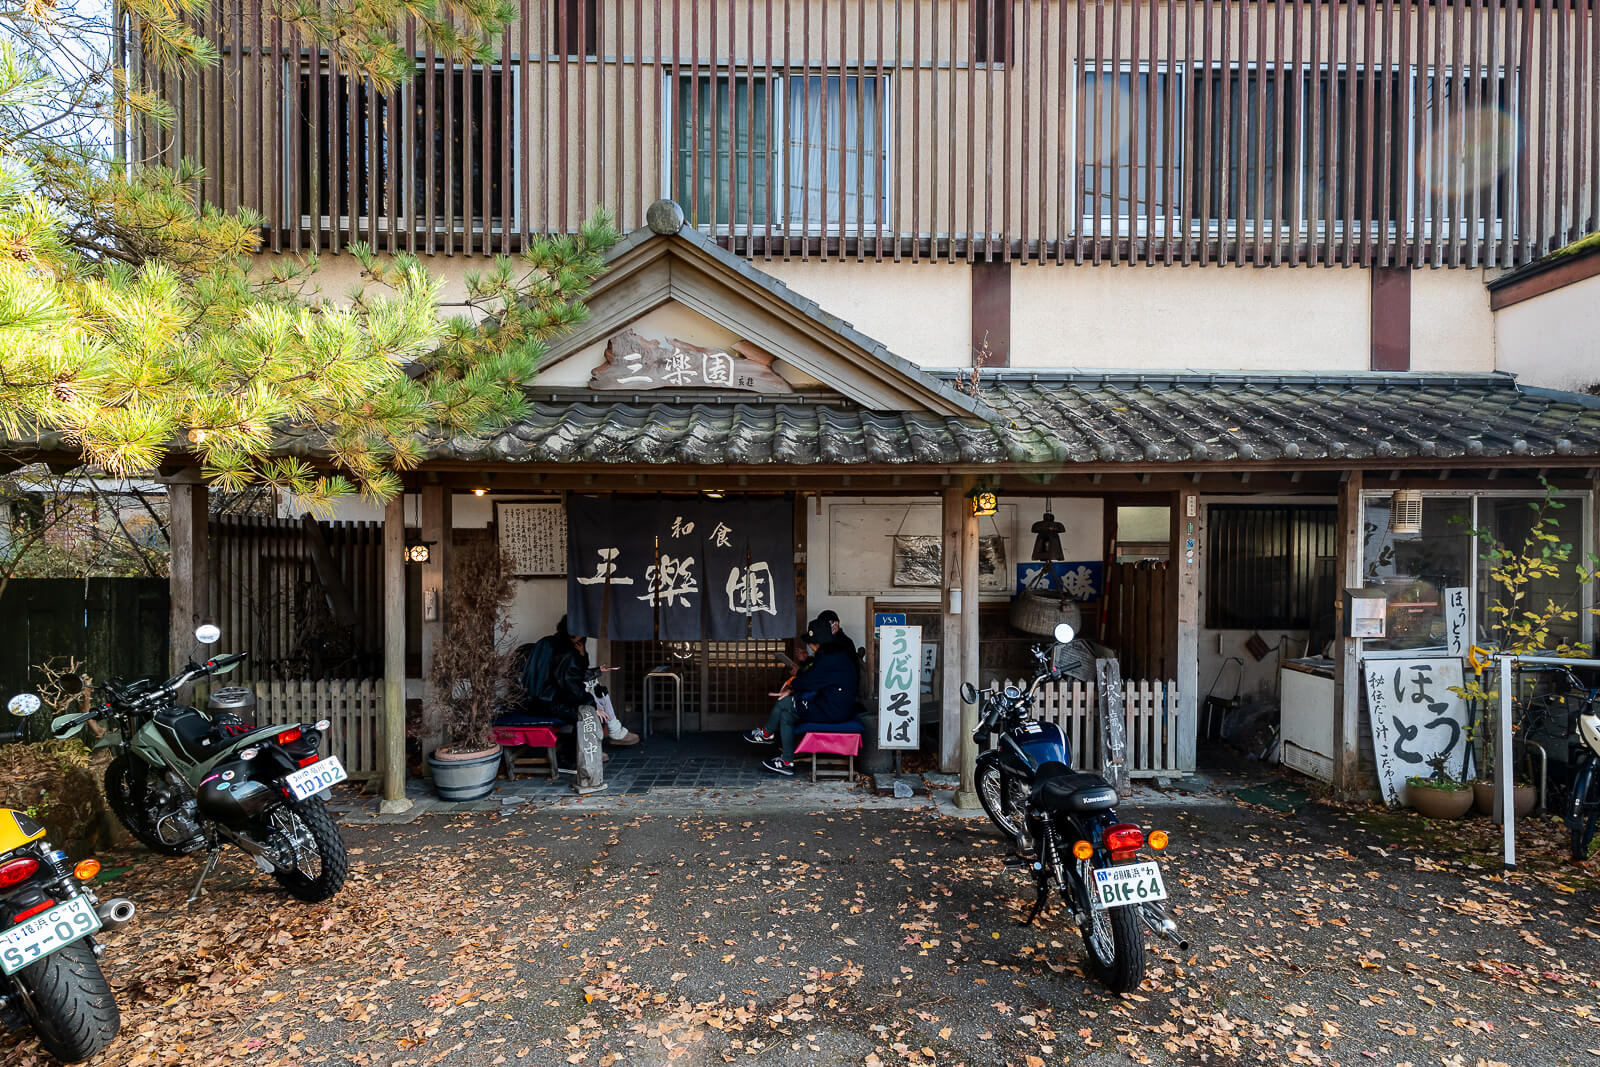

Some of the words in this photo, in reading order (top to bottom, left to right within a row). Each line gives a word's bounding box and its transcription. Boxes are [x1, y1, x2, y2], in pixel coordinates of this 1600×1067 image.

[616, 348, 735, 387] 三楽園
[670, 515, 733, 548] 和食
[1450, 591, 1467, 654] ほうとう
[583, 711, 598, 762] 商い中
[1392, 664, 1462, 782] ほうと
[1083, 794, 1112, 804] Kawasaki
